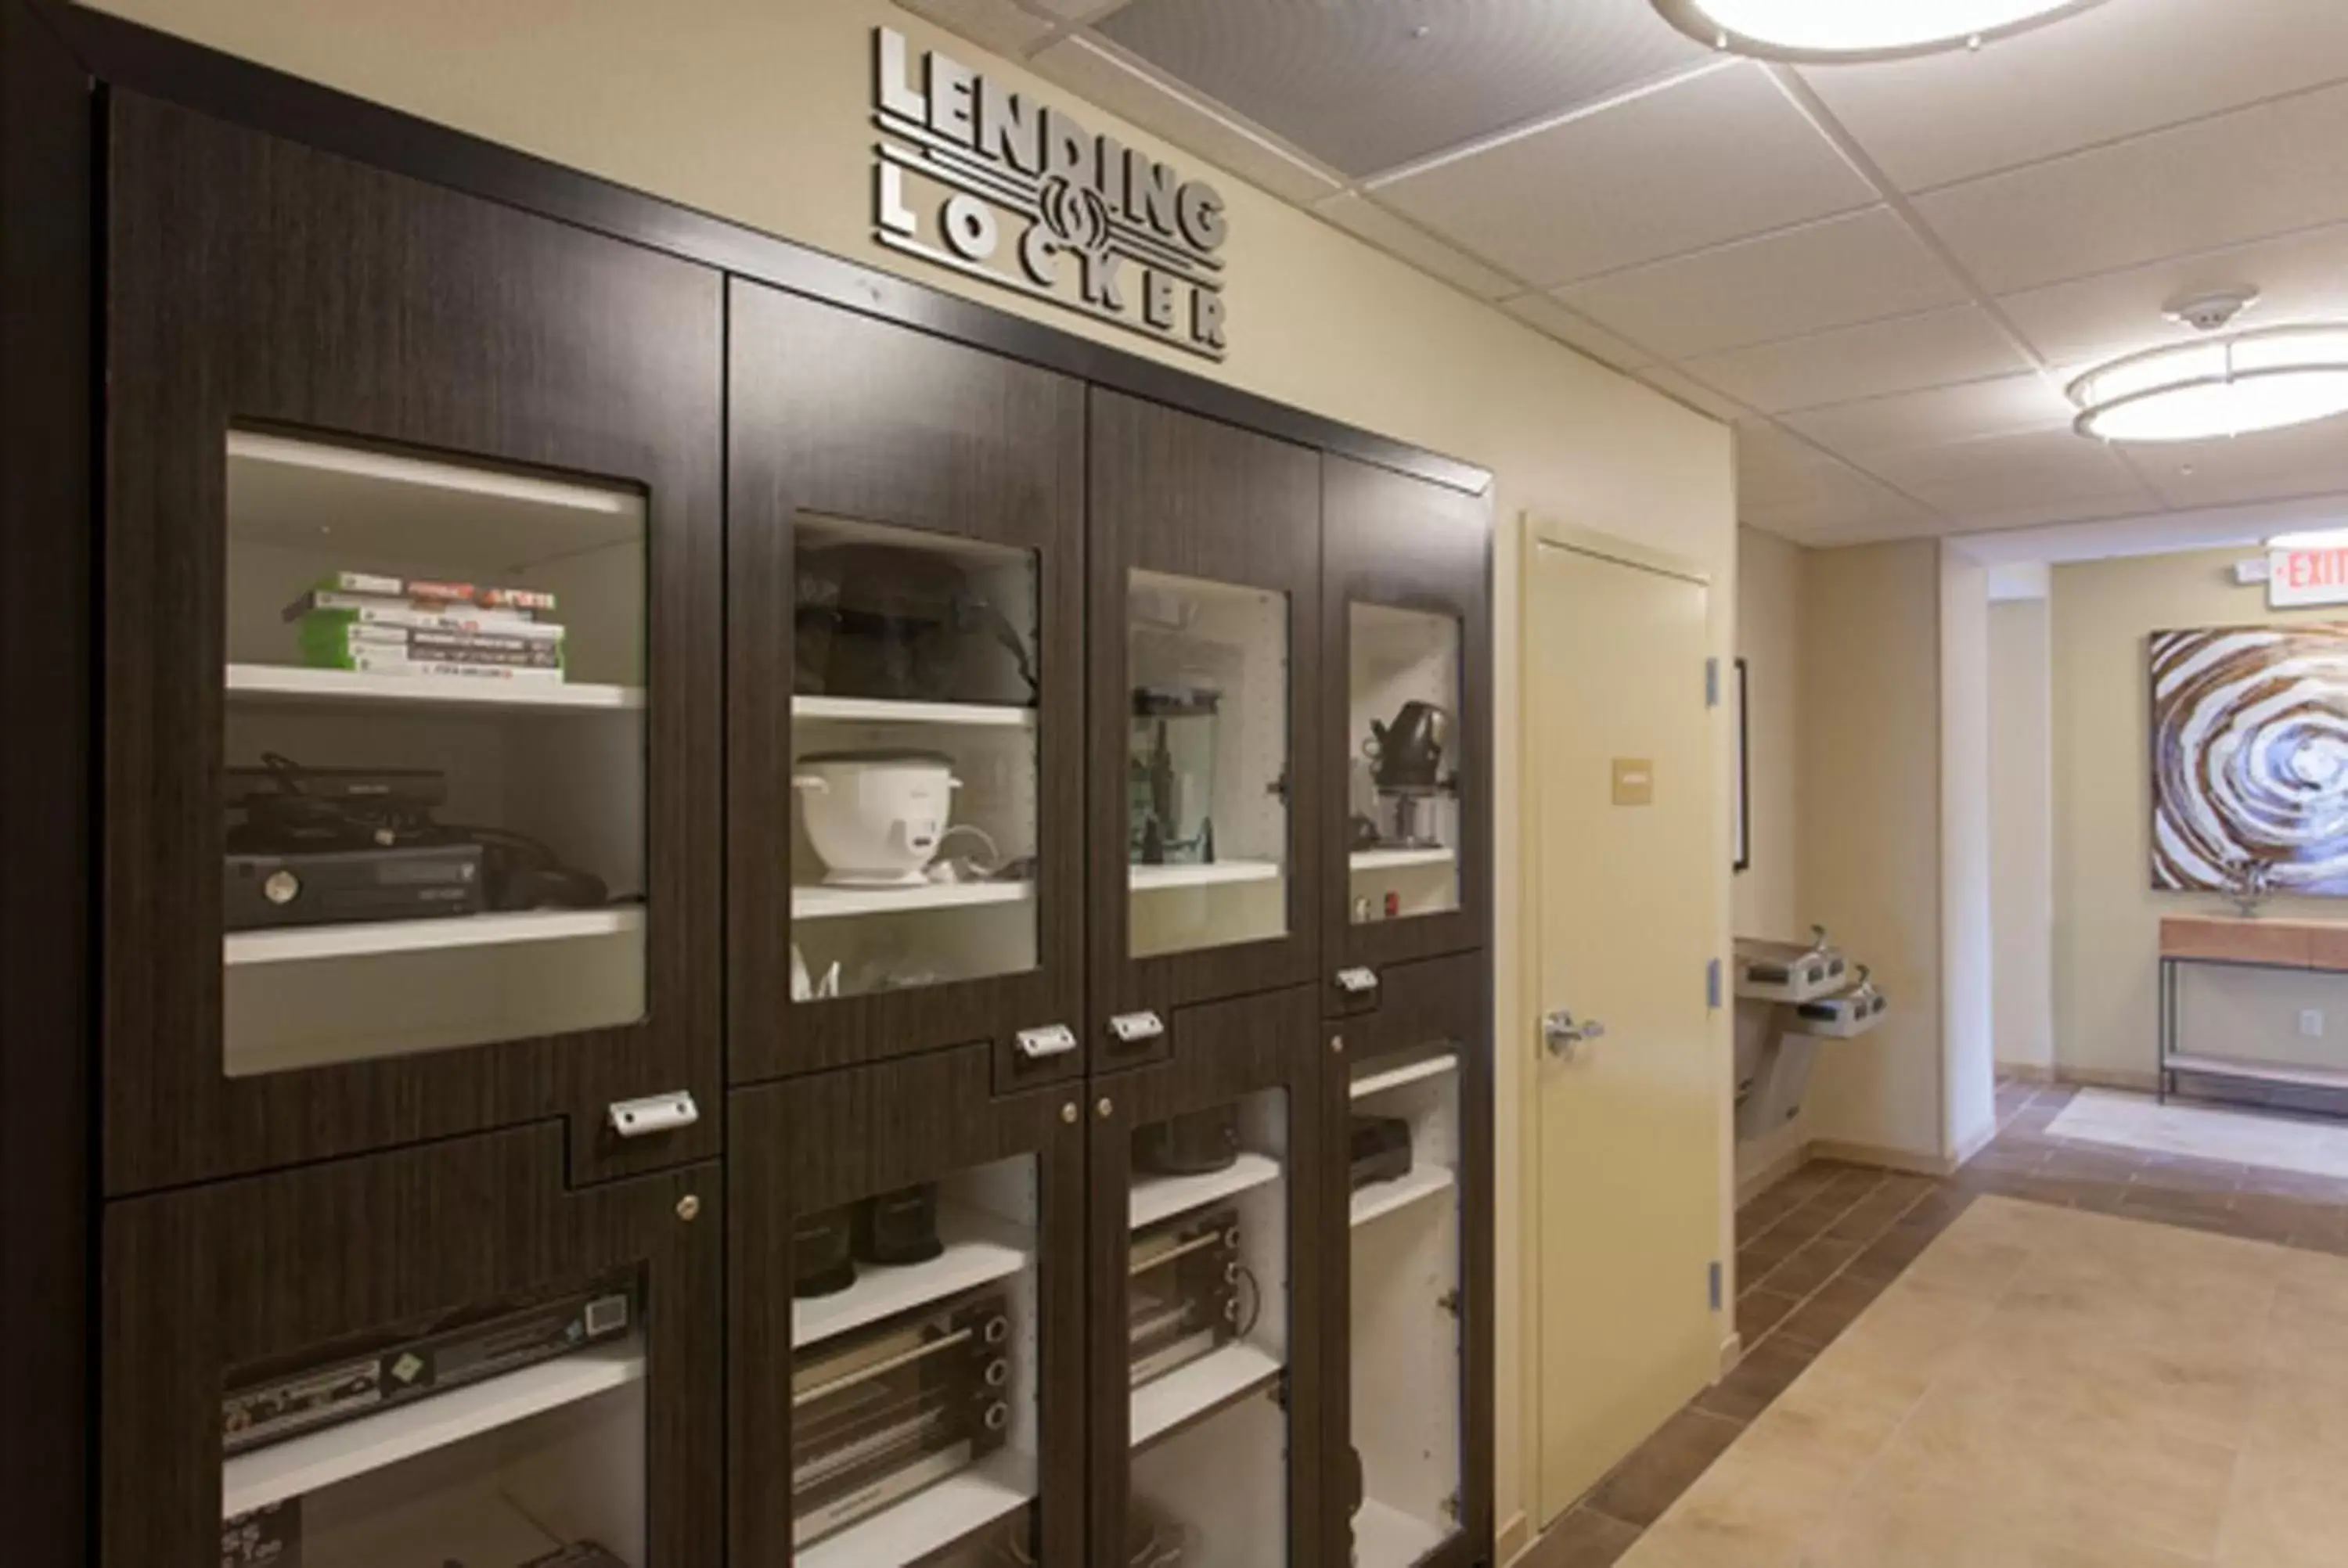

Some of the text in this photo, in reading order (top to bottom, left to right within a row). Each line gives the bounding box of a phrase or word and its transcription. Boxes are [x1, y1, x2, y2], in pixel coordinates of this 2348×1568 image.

[871, 26, 1228, 254] LENDING
[872, 159, 1227, 349] LOCKER
[2288, 548, 2348, 588] EXIT
